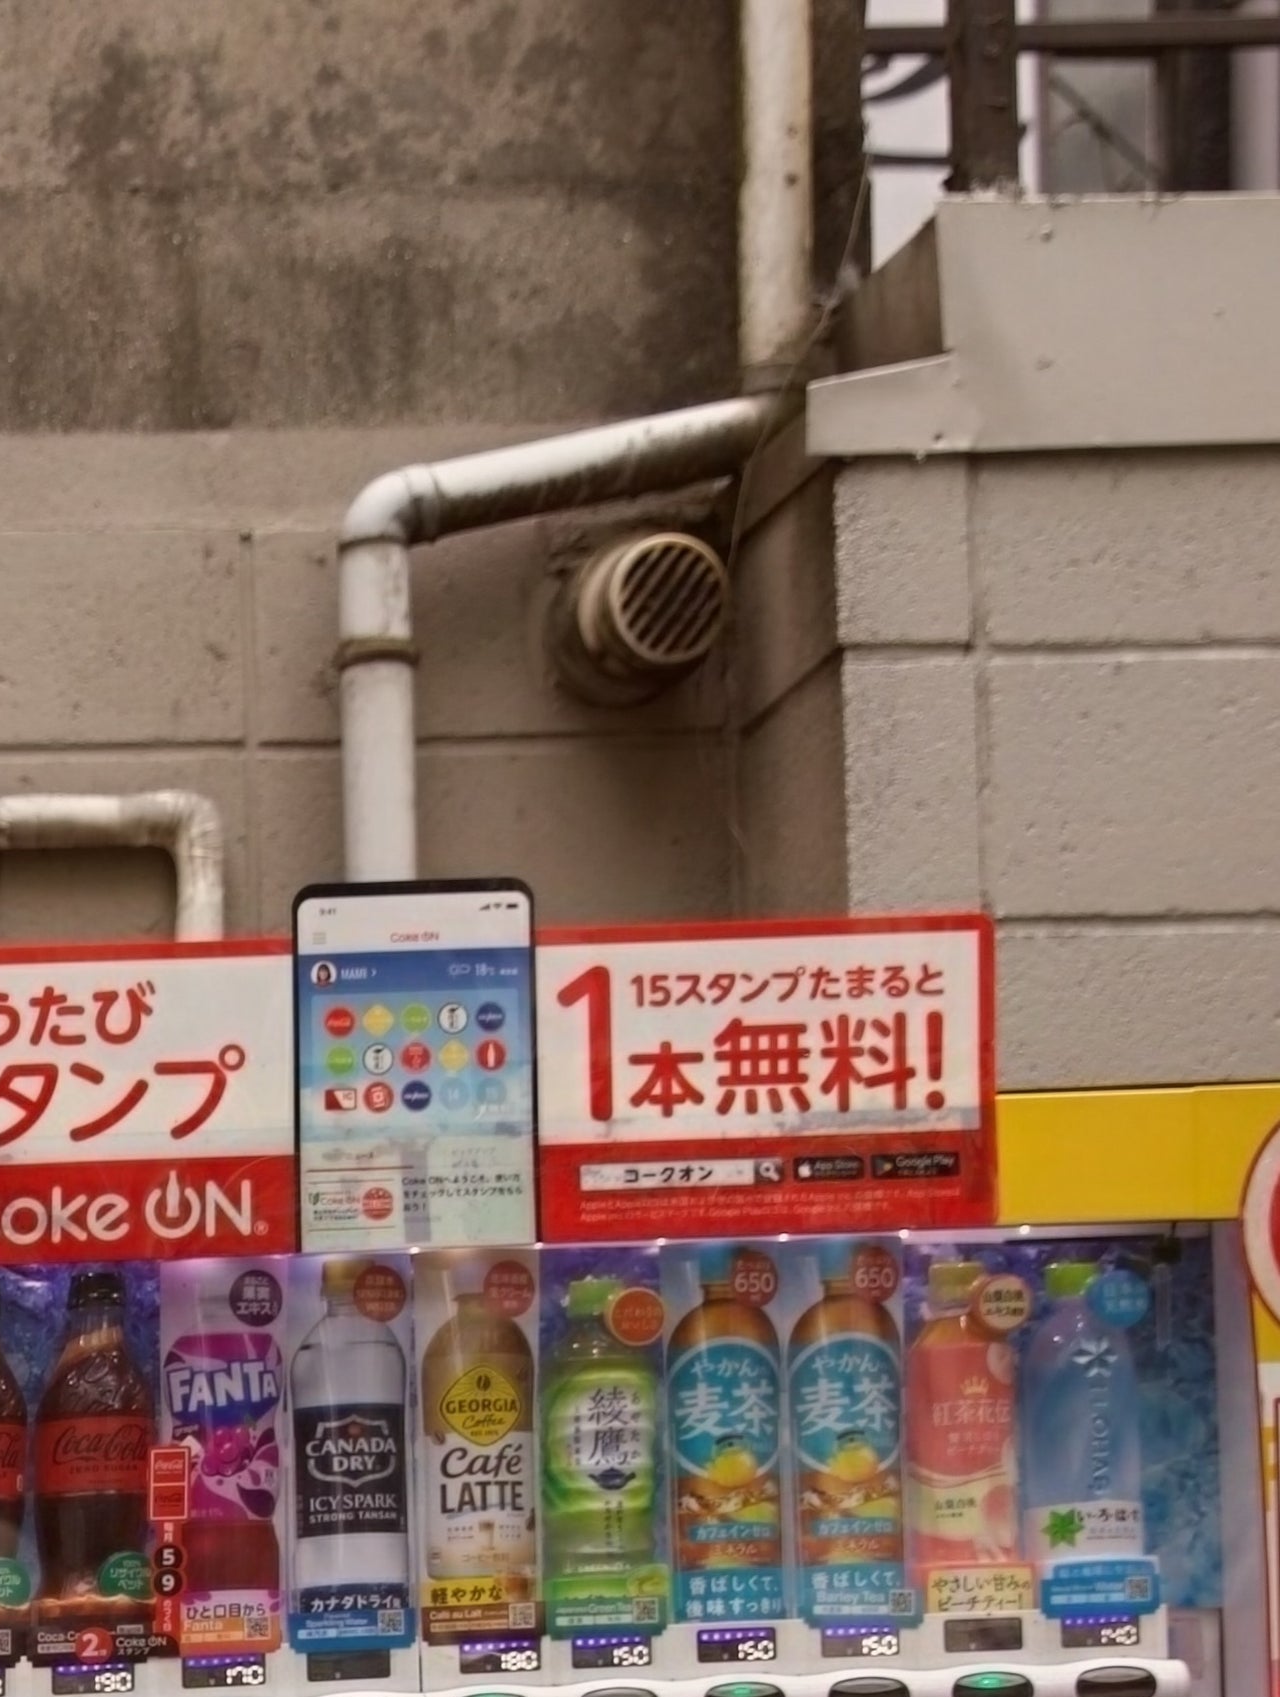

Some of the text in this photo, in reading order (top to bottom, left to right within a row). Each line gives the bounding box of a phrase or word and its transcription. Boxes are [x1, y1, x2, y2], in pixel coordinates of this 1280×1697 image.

[630, 963, 946, 1008] 15スタンプたまると
[557, 964, 615, 1122] 1
[629, 1010, 947, 1118] 本無料!
[624, 1166, 714, 1184] コークオン
[733, 1268, 775, 1294] 650
[169, 1358, 278, 1414] FANTA
[445, 1397, 519, 1415] GEORGIA
[676, 1382, 778, 1440] 麦茶
[797, 1378, 898, 1436] 麦茶
[306, 1436, 397, 1457] CANADA
[332, 1451, 375, 1473] DRY
[439, 1445, 523, 1479] Café
[309, 1493, 398, 1511] ICY SPARK
[441, 1480, 524, 1513] LATTE
[308, 1509, 398, 1523] STRONG TANSAN
[695, 1524, 770, 1541] カフェインゼロ
[430, 1586, 502, 1605] 軽やかな
[685, 1595, 781, 1618] 後味すっきり
[185, 1602, 267, 1620] ひと口目から
